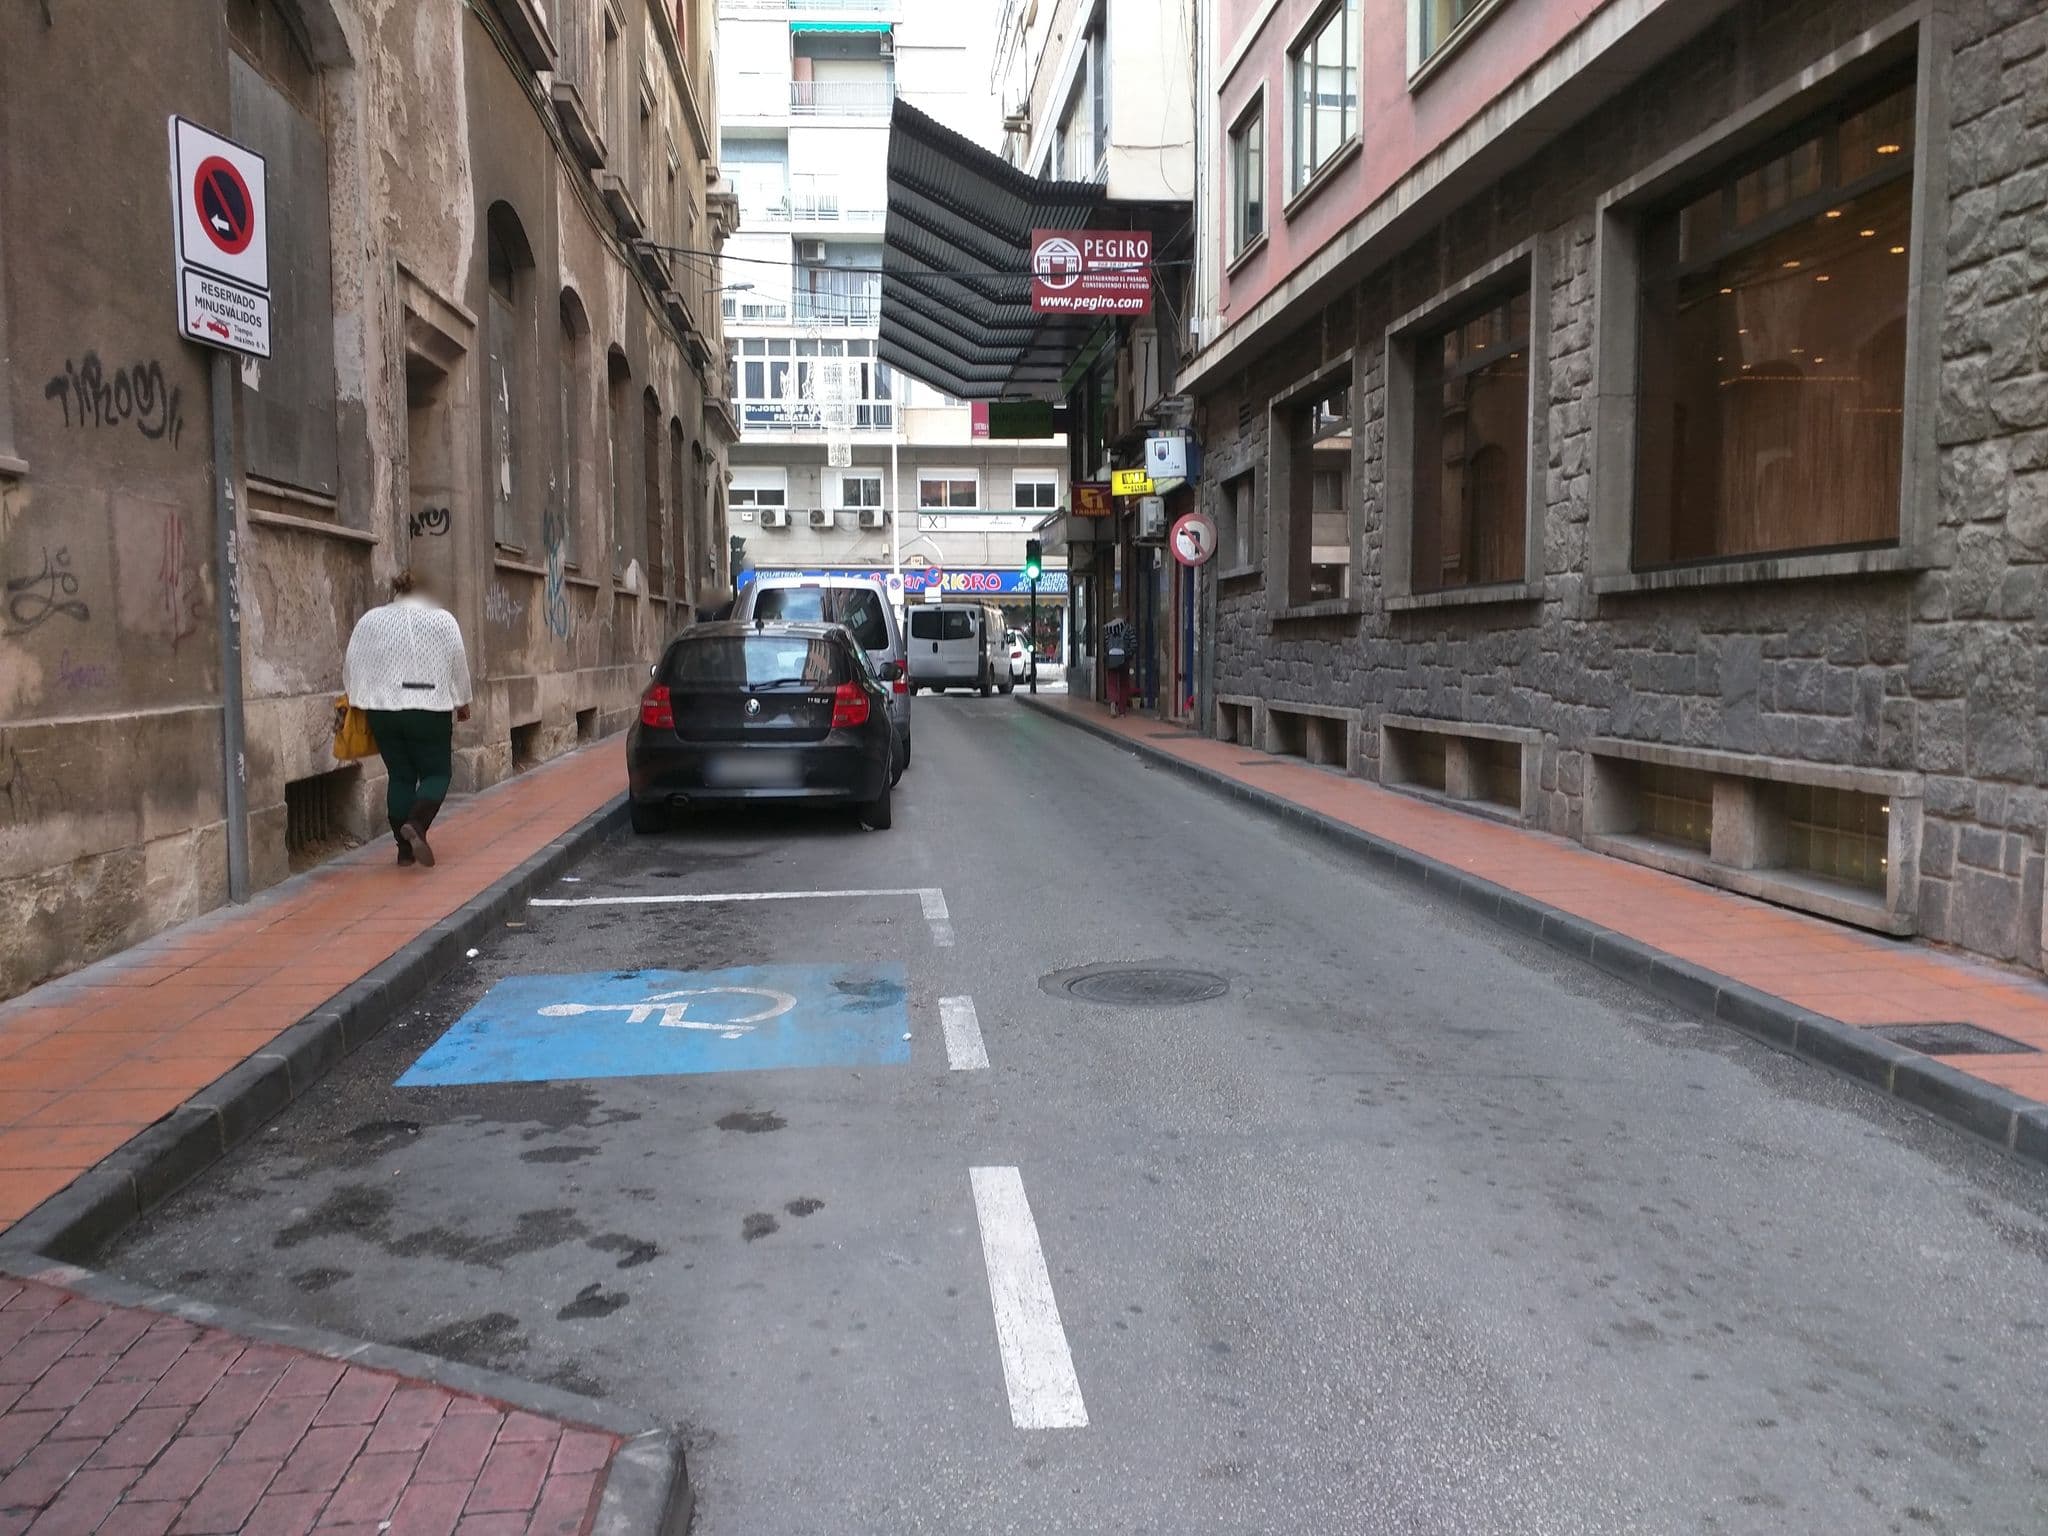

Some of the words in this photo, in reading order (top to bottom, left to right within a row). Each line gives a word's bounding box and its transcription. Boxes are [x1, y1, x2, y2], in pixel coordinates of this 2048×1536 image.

[1084, 239, 1148, 258] PEGIRO
[201, 281, 255, 310] RESERVADO
[1040, 295, 1144, 310] www.pegiro.com
